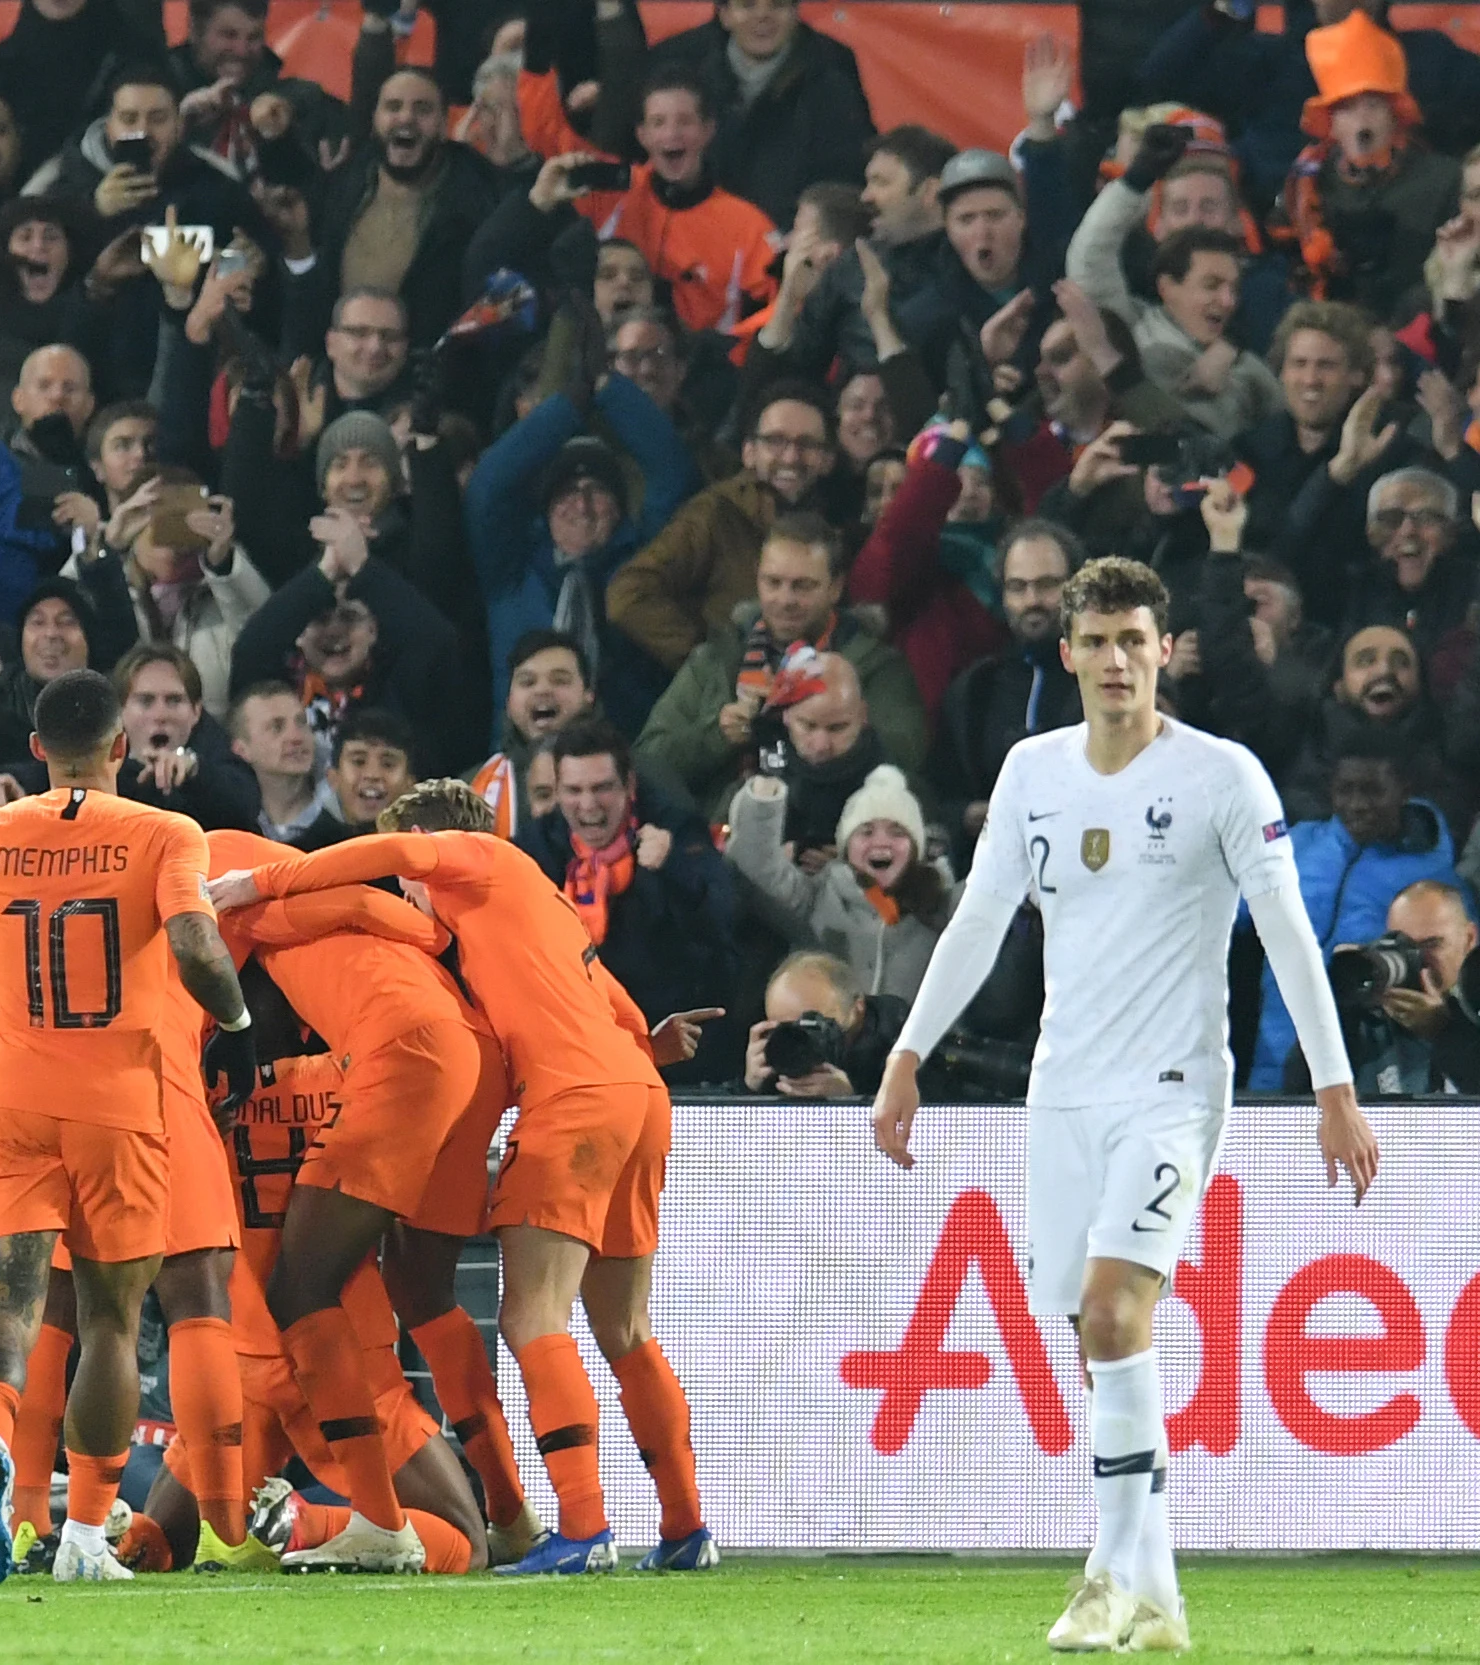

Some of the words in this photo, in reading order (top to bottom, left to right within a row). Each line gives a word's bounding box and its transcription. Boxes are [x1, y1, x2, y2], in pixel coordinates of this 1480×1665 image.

[1030, 835, 1057, 893] 2
[1, 897, 123, 1029] 10
[1144, 1162, 1181, 1221] 2
[839, 1173, 1480, 1456] Ade
